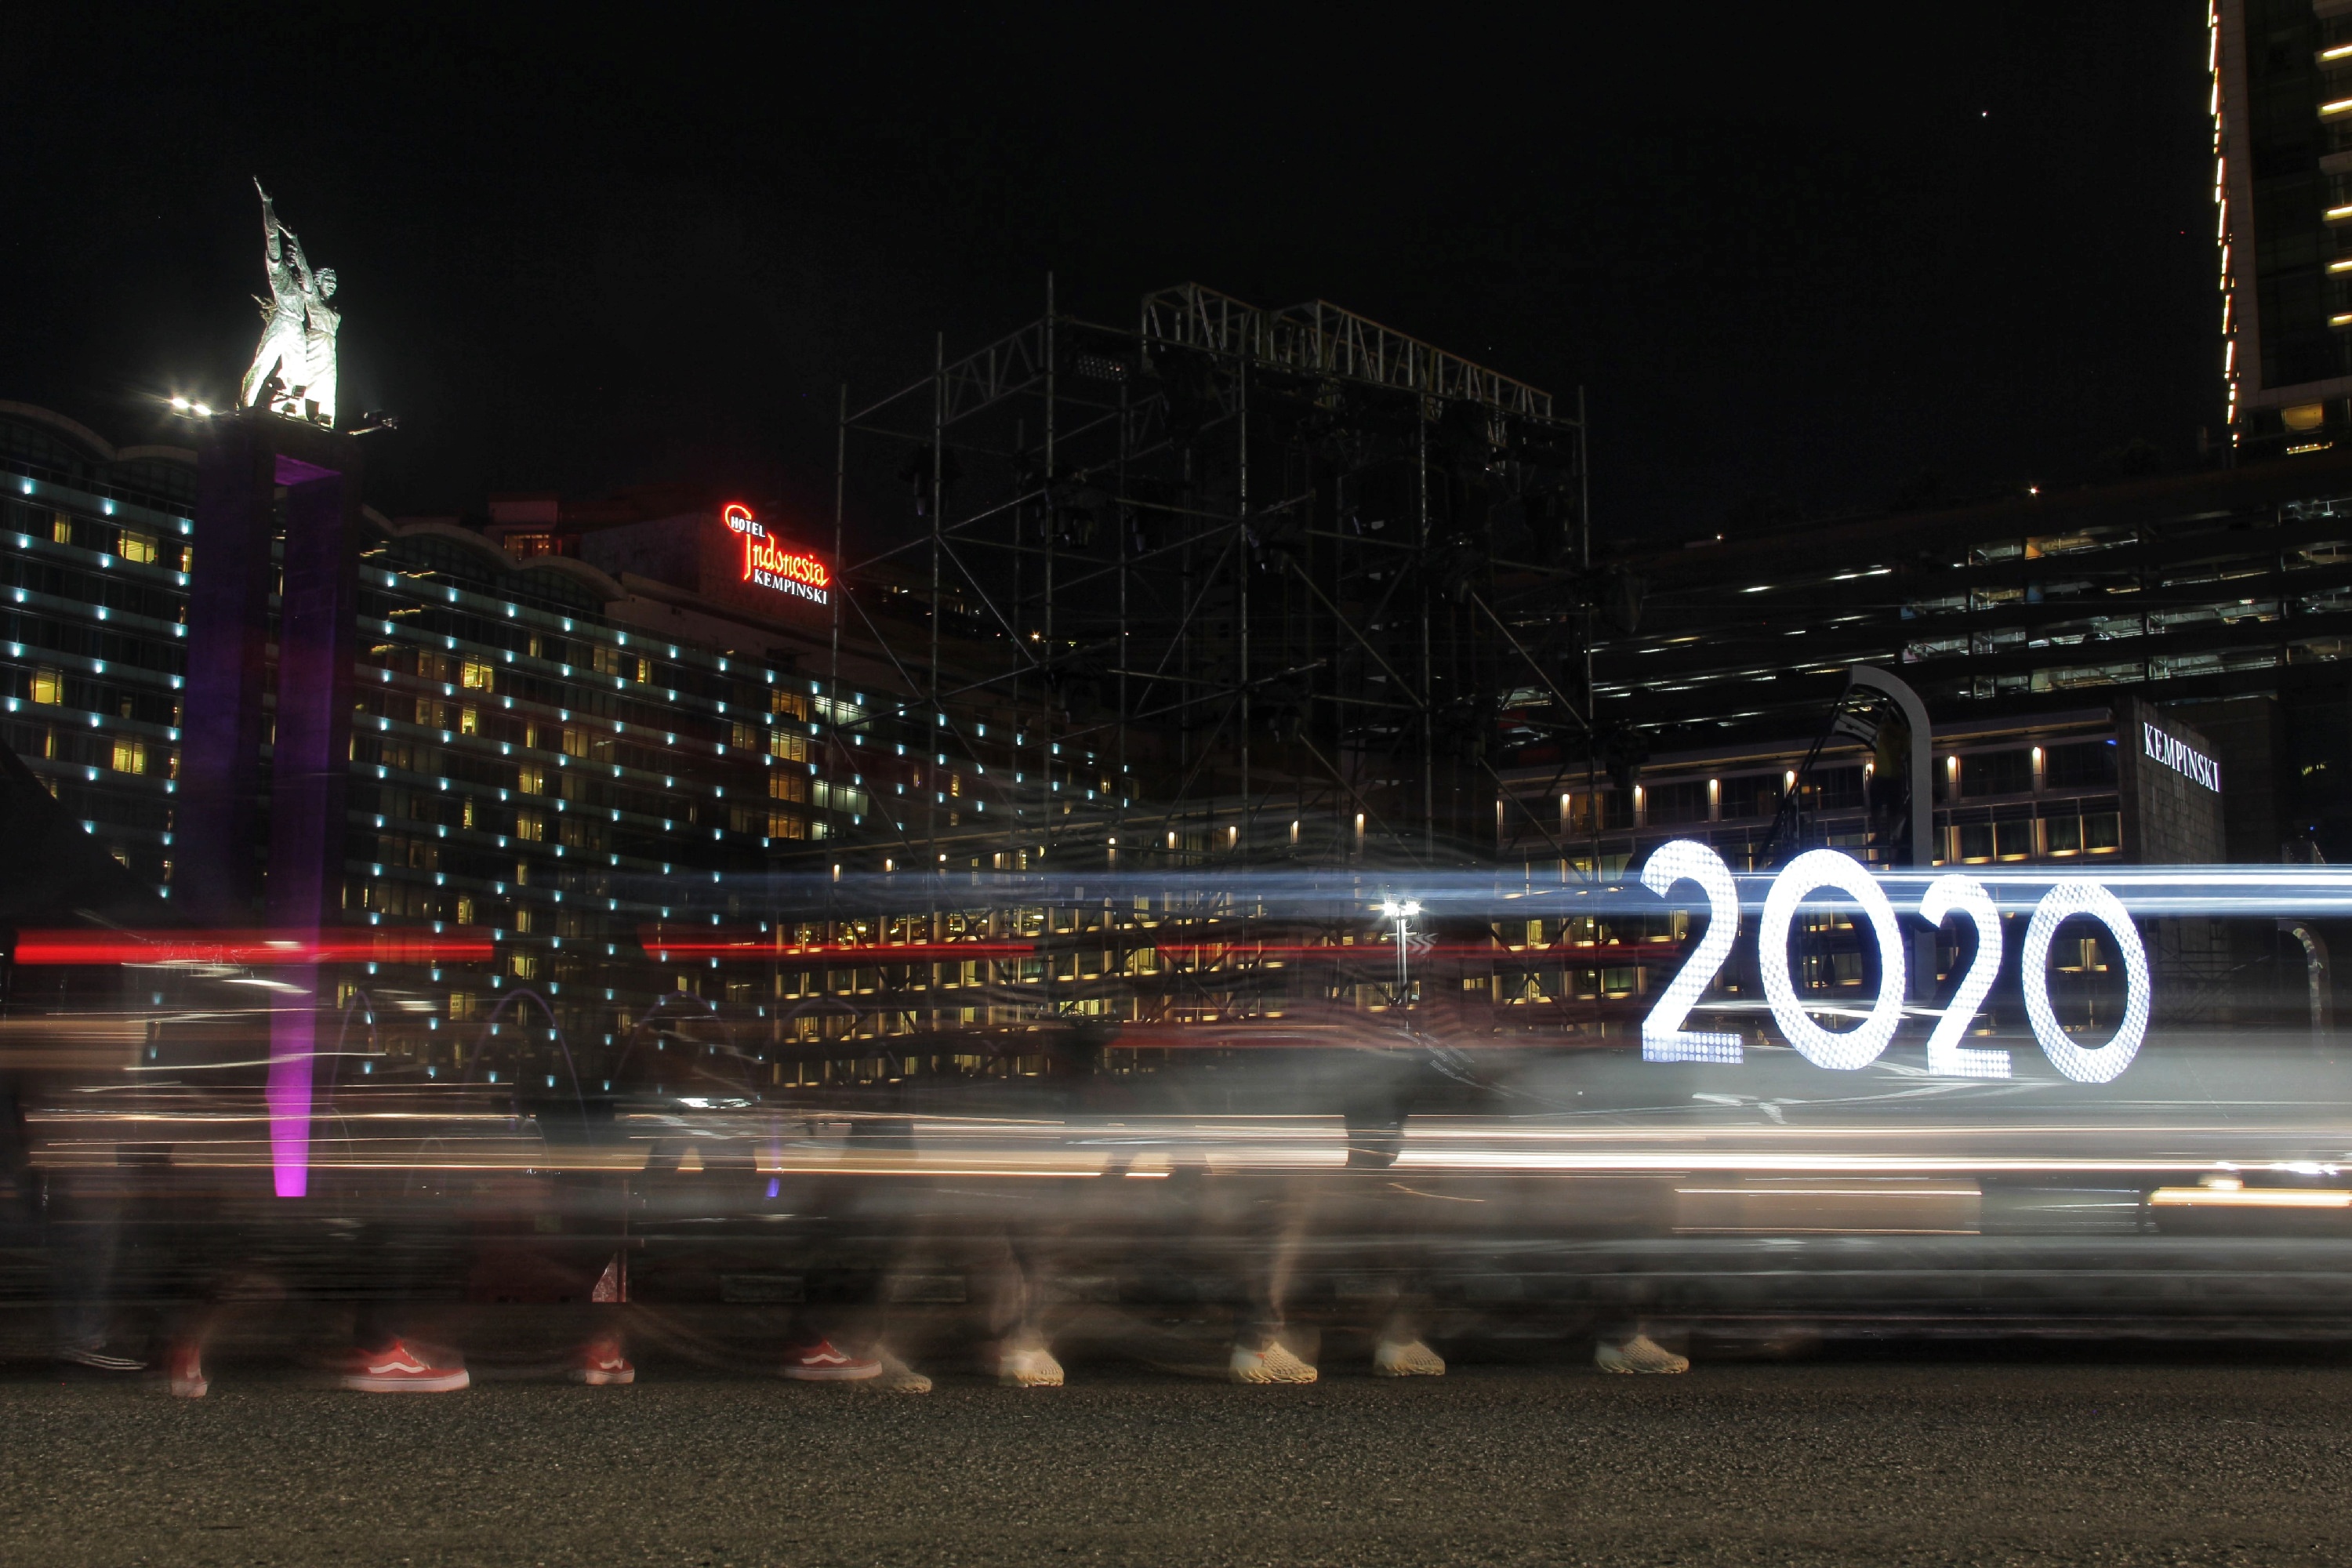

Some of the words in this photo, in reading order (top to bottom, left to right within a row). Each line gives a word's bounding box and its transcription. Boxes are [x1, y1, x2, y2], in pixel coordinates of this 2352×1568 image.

[724, 504, 829, 586] Indonesia
[731, 516, 766, 538] HOTEL
[754, 568, 828, 604] KEMPINSKI
[2143, 721, 2220, 793] KEMPINSKI
[1639, 838, 2151, 1083] 2020
